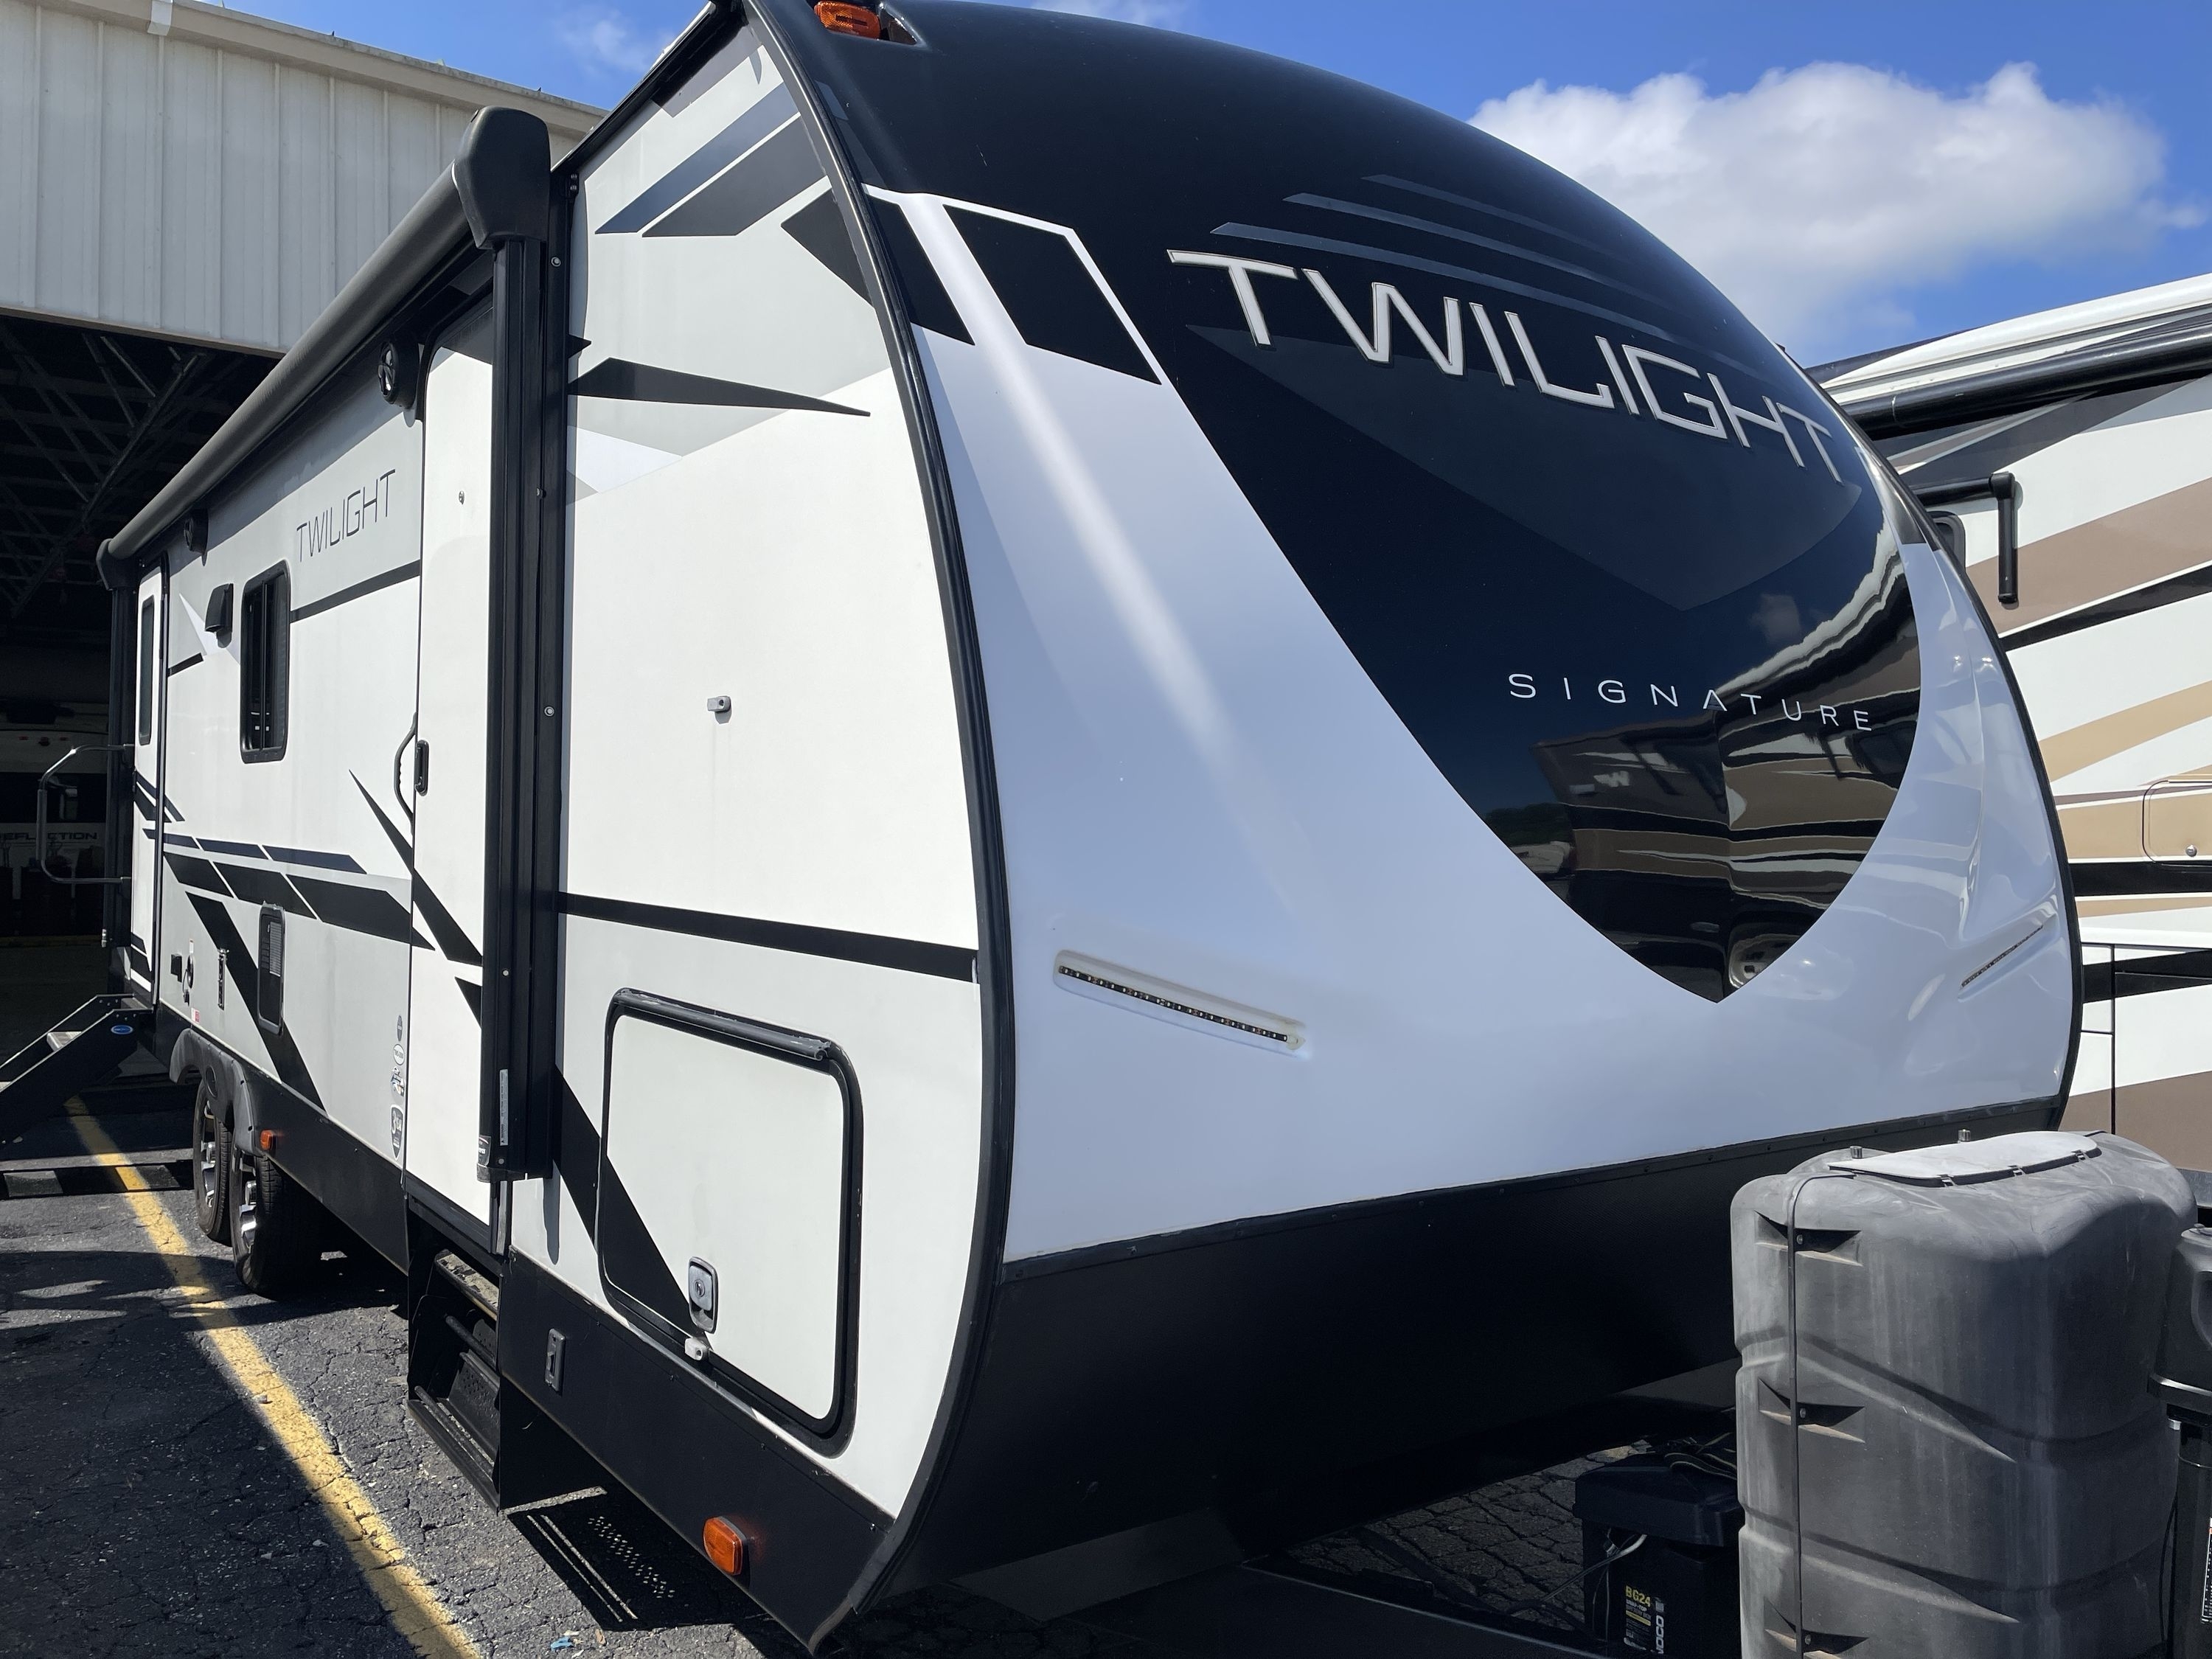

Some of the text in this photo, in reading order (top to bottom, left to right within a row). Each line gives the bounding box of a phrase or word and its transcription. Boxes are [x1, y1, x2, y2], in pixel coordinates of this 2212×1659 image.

[1167, 248, 1843, 486] TWILIGHT
[296, 468, 396, 563] TWILIGHT
[1508, 672, 1873, 731] SIGNATURE
[0, 832, 97, 840] EFLCTION
[1625, 1585, 1651, 1607] BG24
